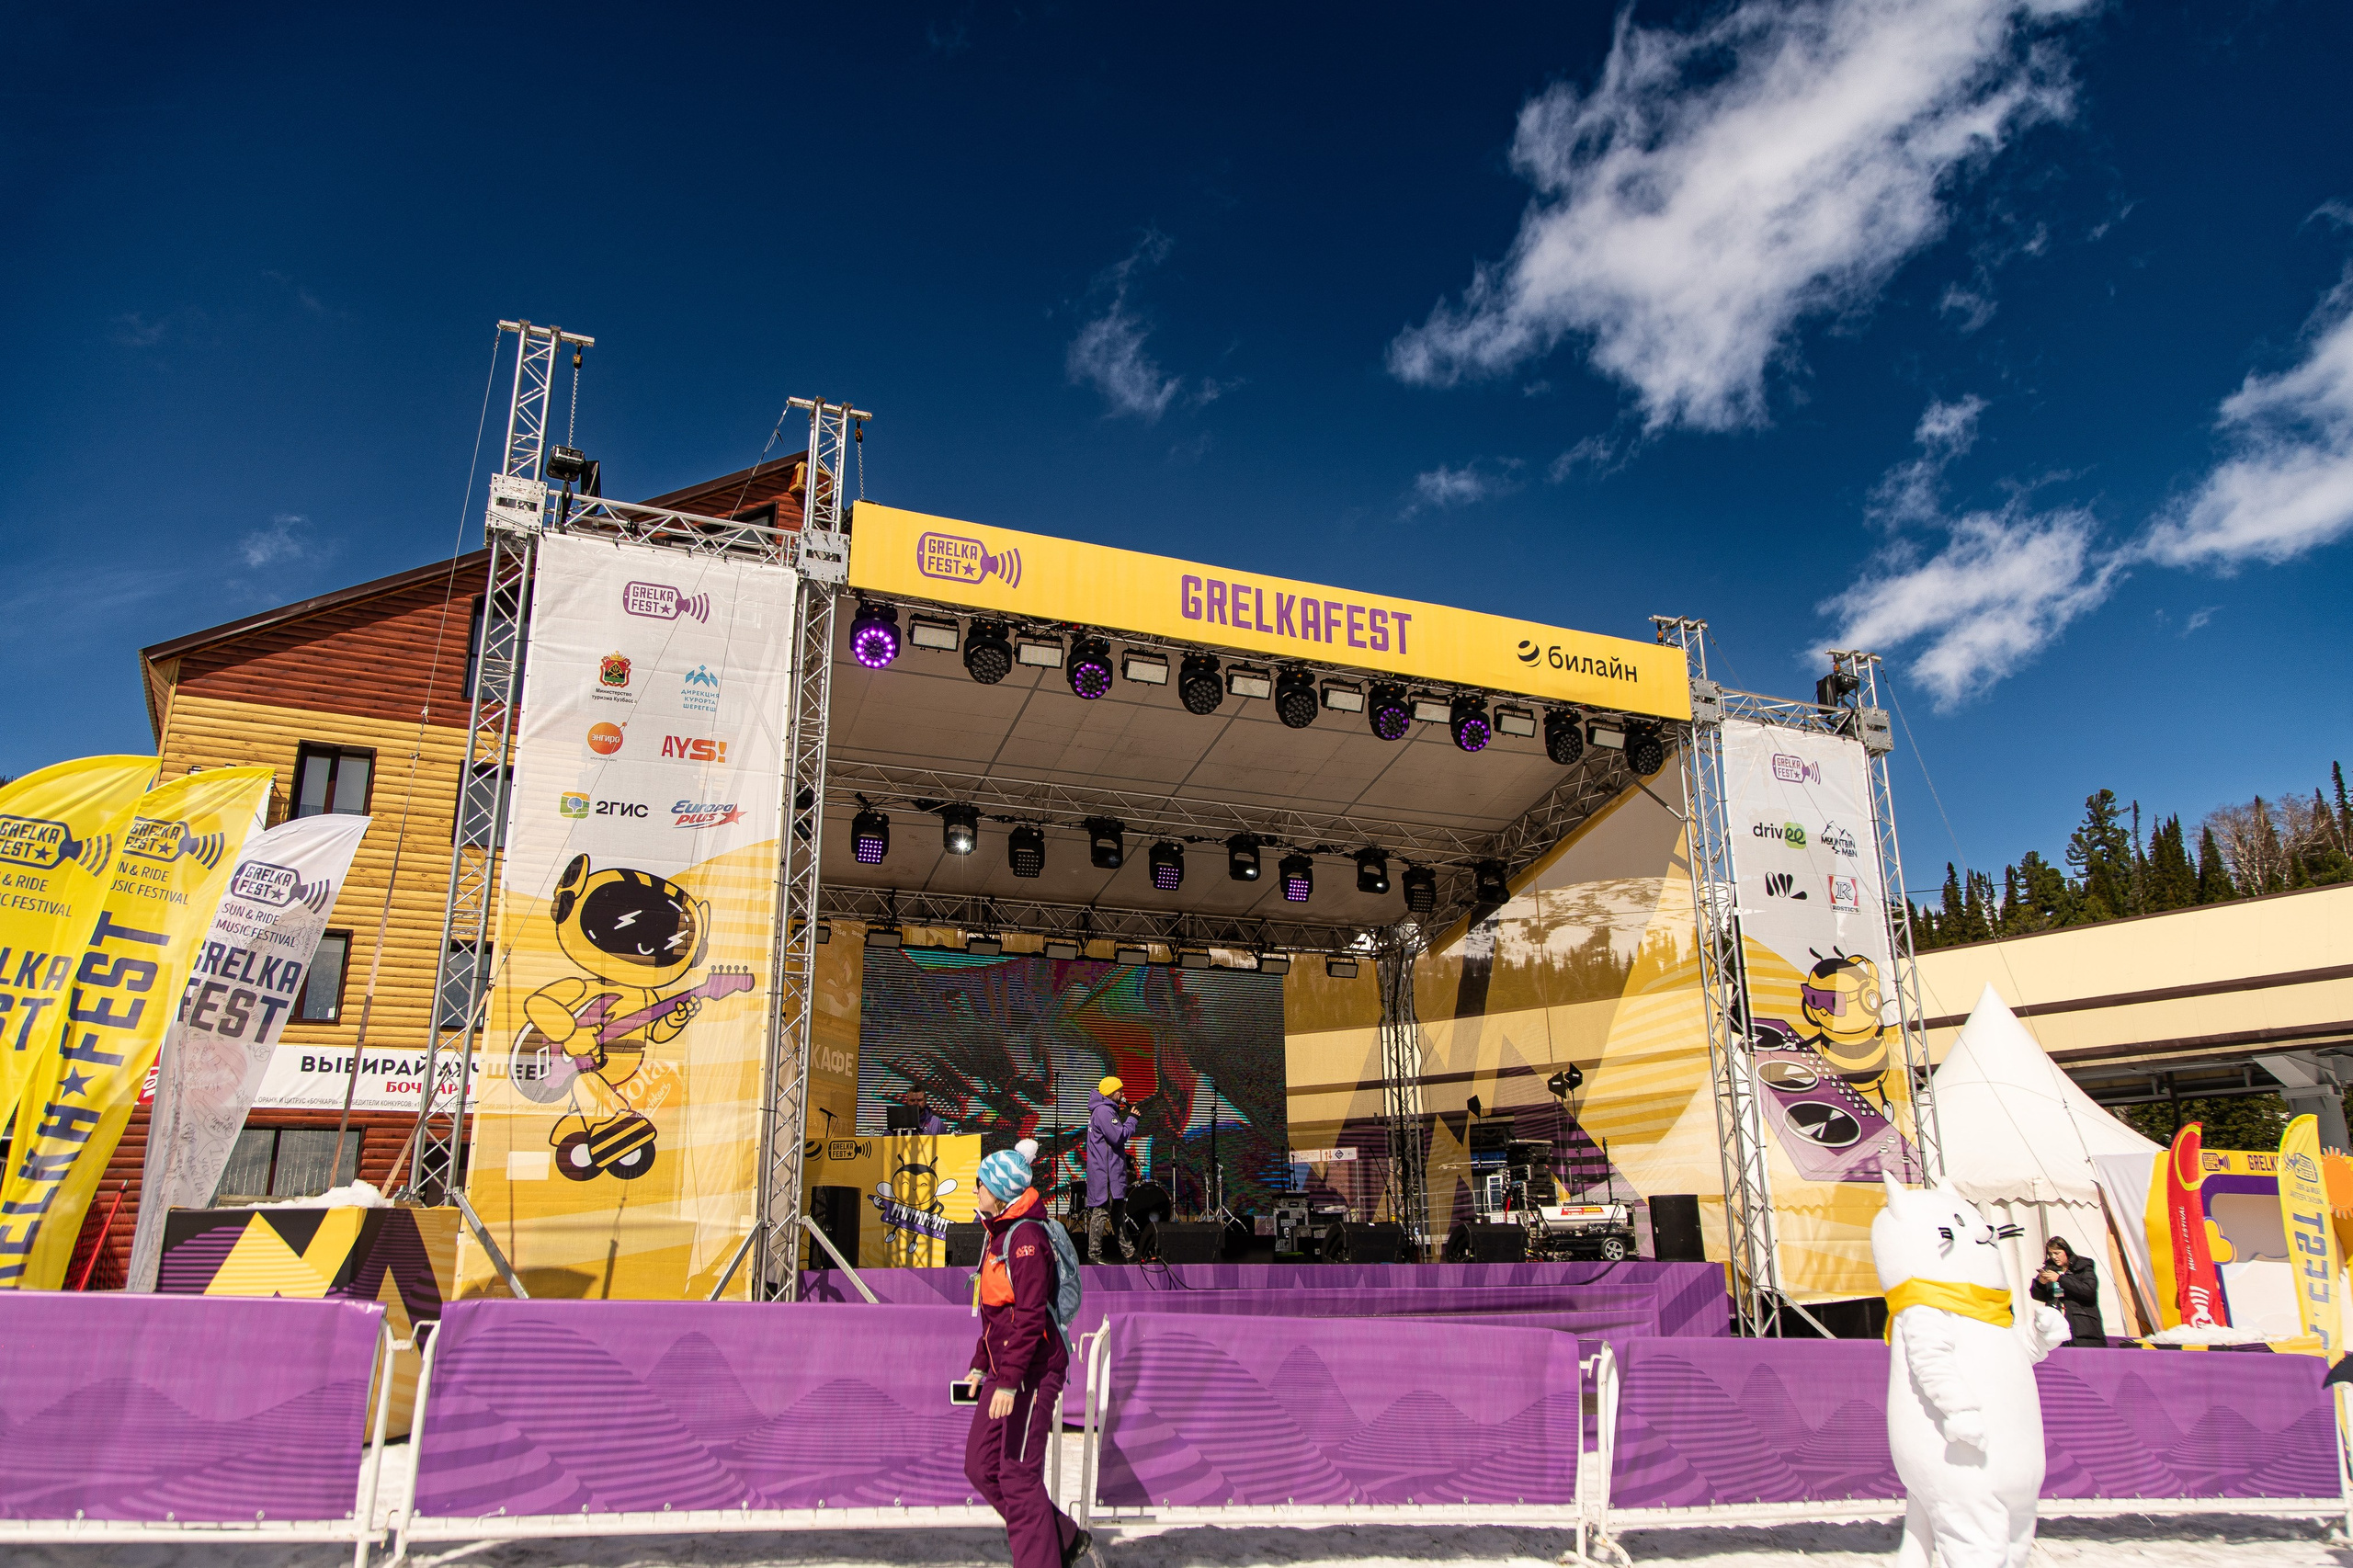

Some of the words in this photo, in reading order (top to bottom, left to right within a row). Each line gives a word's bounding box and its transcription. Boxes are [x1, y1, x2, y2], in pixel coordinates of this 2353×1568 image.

[928, 539, 977, 560] GRELKA
[927, 555, 961, 574] FEST
[632, 585, 674, 602] GRELKA
[631, 598, 660, 613] FEST
[1181, 574, 1412, 654] GRELKAFEST
[1548, 645, 1638, 683] билайн
[596, 687, 632, 697] Министерство
[680, 689, 720, 699] ДИРЕКЦИЯ
[684, 696, 716, 705] КУРОРТА
[683, 703, 716, 712] ШЕРЕГЕШ
[591, 733, 620, 744] энгиро
[661, 735, 727, 763] AYS!
[1776, 757, 1801, 769] GRELKA
[1778, 767, 1794, 778] FEST
[596, 801, 649, 818] 2ГИС
[671, 800, 735, 814] Europa
[675, 813, 718, 826] plus
[0, 821, 61, 844] GRELKA
[1753, 822, 1806, 845] drivee
[1821, 835, 1856, 849] MOUNTAIN
[1841, 847, 1858, 858] MAN
[130, 864, 139, 876] &
[141, 866, 170, 882] RIDE
[244, 866, 293, 888] GRELKA
[2, 873, 12, 886] &
[16, 874, 50, 892] RIDE
[238, 880, 274, 898] FEST
[137, 883, 189, 905] FESTIVAL
[11, 895, 73, 917] FESTIVAL
[222, 903, 245, 918] SUN
[244, 908, 254, 920] &
[255, 912, 280, 926] RIDE
[1832, 904, 1859, 914] ROSTIC'S
[215, 919, 249, 937] MUSIC
[251, 927, 297, 948] FESTIVAL
[59, 911, 171, 1067] FEST
[810, 1042, 854, 1077] КАФЕ
[832, 1142, 853, 1151] GRELKA
[832, 1150, 847, 1158] FEST
